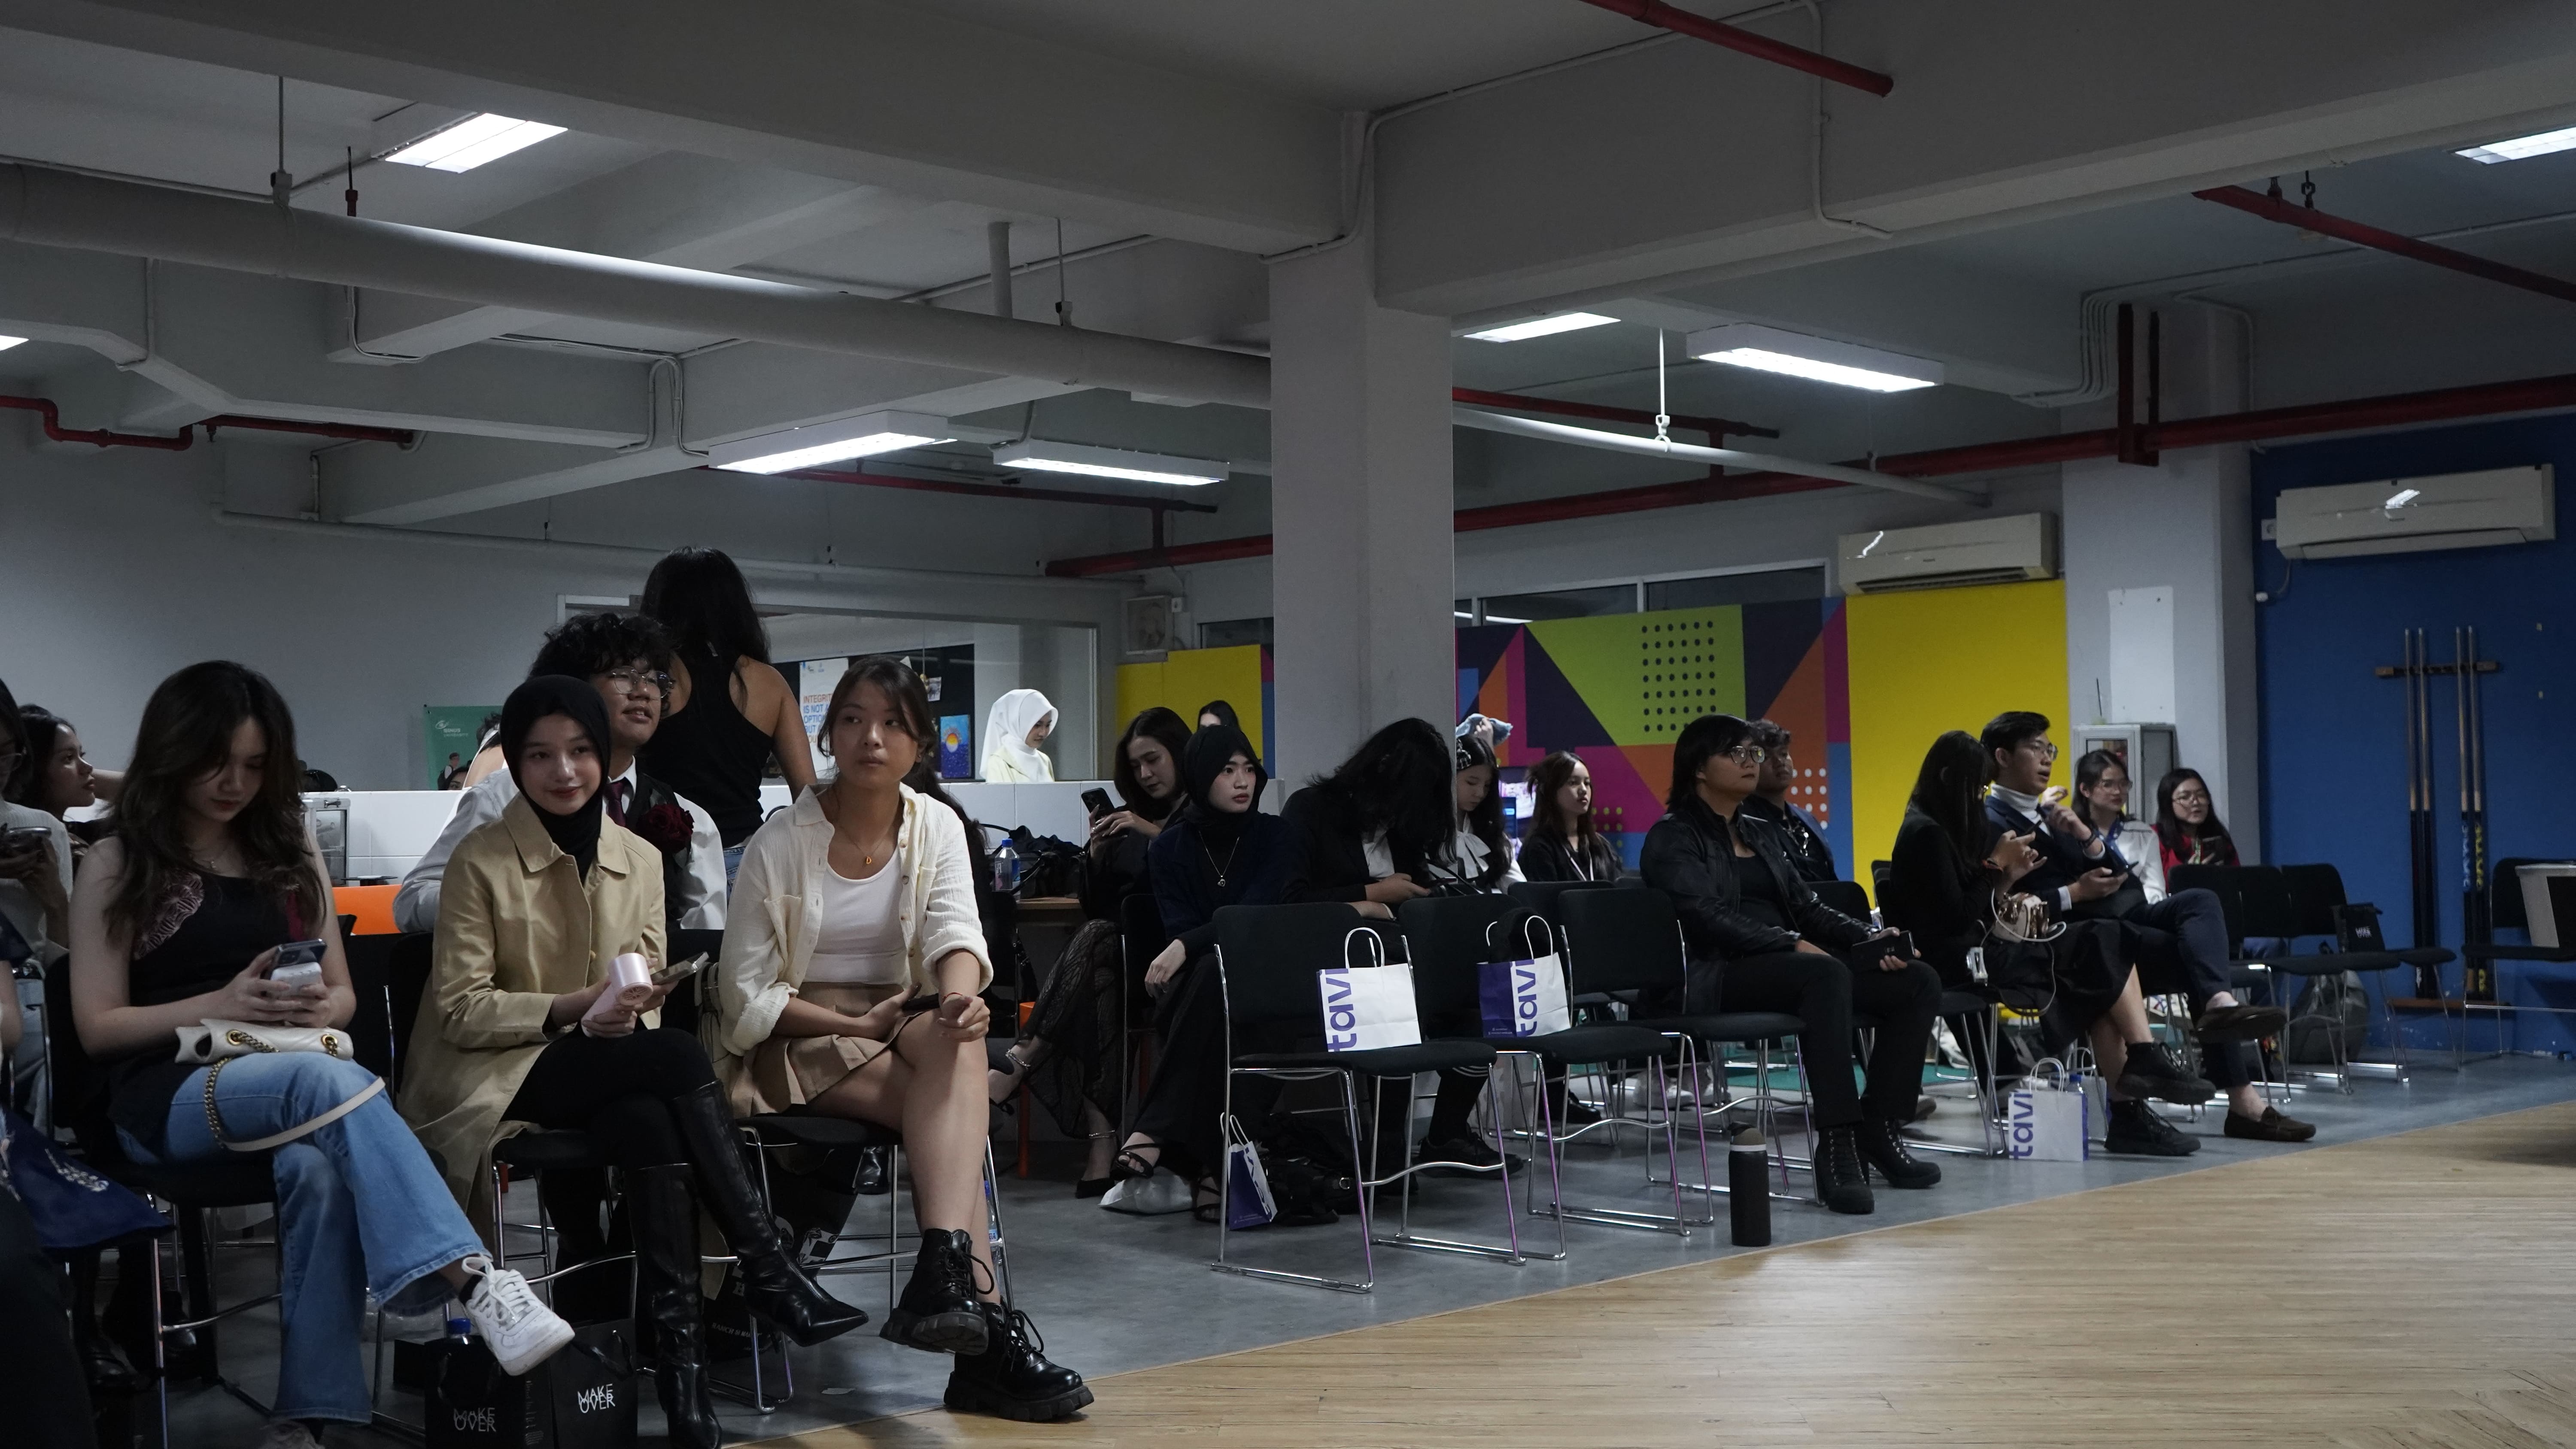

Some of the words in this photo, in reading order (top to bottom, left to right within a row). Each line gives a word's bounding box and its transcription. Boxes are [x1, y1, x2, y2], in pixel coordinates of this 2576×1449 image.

[804, 694, 833, 703] INTEGRIT
[811, 704, 823, 712] NOT
[1510, 958, 1537, 1037] tavi
[1325, 967, 1357, 1052] tavi
[2009, 1093, 2034, 1160] tavi
[711, 1322, 734, 1334] RANCH
[577, 1383, 614, 1405] MAKE
[580, 1392, 616, 1414] OVER
[453, 1407, 495, 1422] MAKE
[455, 1415, 497, 1432] OVER
